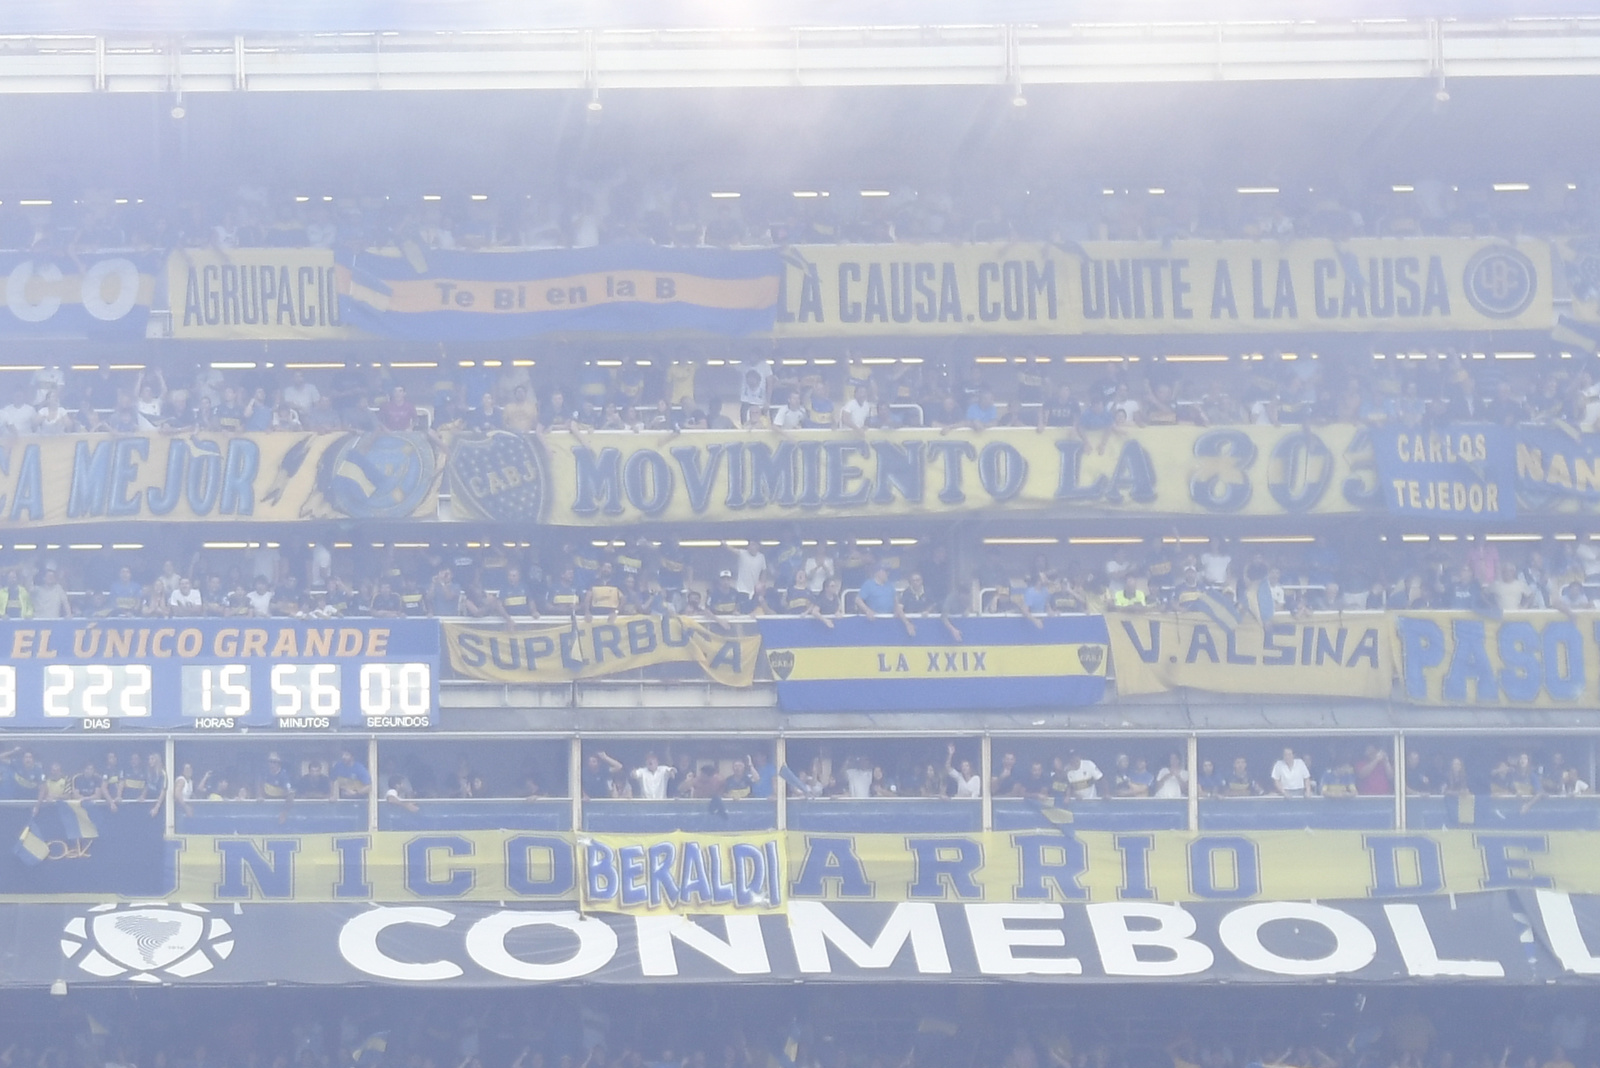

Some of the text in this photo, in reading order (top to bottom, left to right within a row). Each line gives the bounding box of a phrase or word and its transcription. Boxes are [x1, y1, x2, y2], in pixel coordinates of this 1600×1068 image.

[435, 281, 474, 308] Te
[546, 281, 587, 307] en
[606, 274, 636, 300] la
[839, 260, 1057, 324] CAUSA.COM
[1081, 258, 1193, 321] UNITE
[1210, 258, 1238, 320] A
[1252, 257, 1298, 320] LA
[1314, 254, 1451, 319] CAUSA
[572, 438, 1027, 517] MOVIMIENTO
[1055, 434, 1158, 502] LA
[1397, 433, 1487, 463] CARLOS
[1393, 479, 1499, 513] TEJEDOR
[11, 622, 390, 659] EL ÚNICO GRANDE
[878, 651, 988, 673] LA XXIX
[1401, 617, 1586, 700] PASO
[43, 664, 152, 717] 222
[201, 664, 251, 715] 15
[270, 664, 341, 715] 56
[359, 662, 431, 715] 00
[83, 718, 111, 730] DIAS
[195, 717, 234, 730] HORAS
[279, 717, 330, 729] MINUTOS
[587, 839, 781, 909] BERALDI
[1361, 832, 1554, 900] DE
[338, 900, 1505, 981] CONMEBOL
